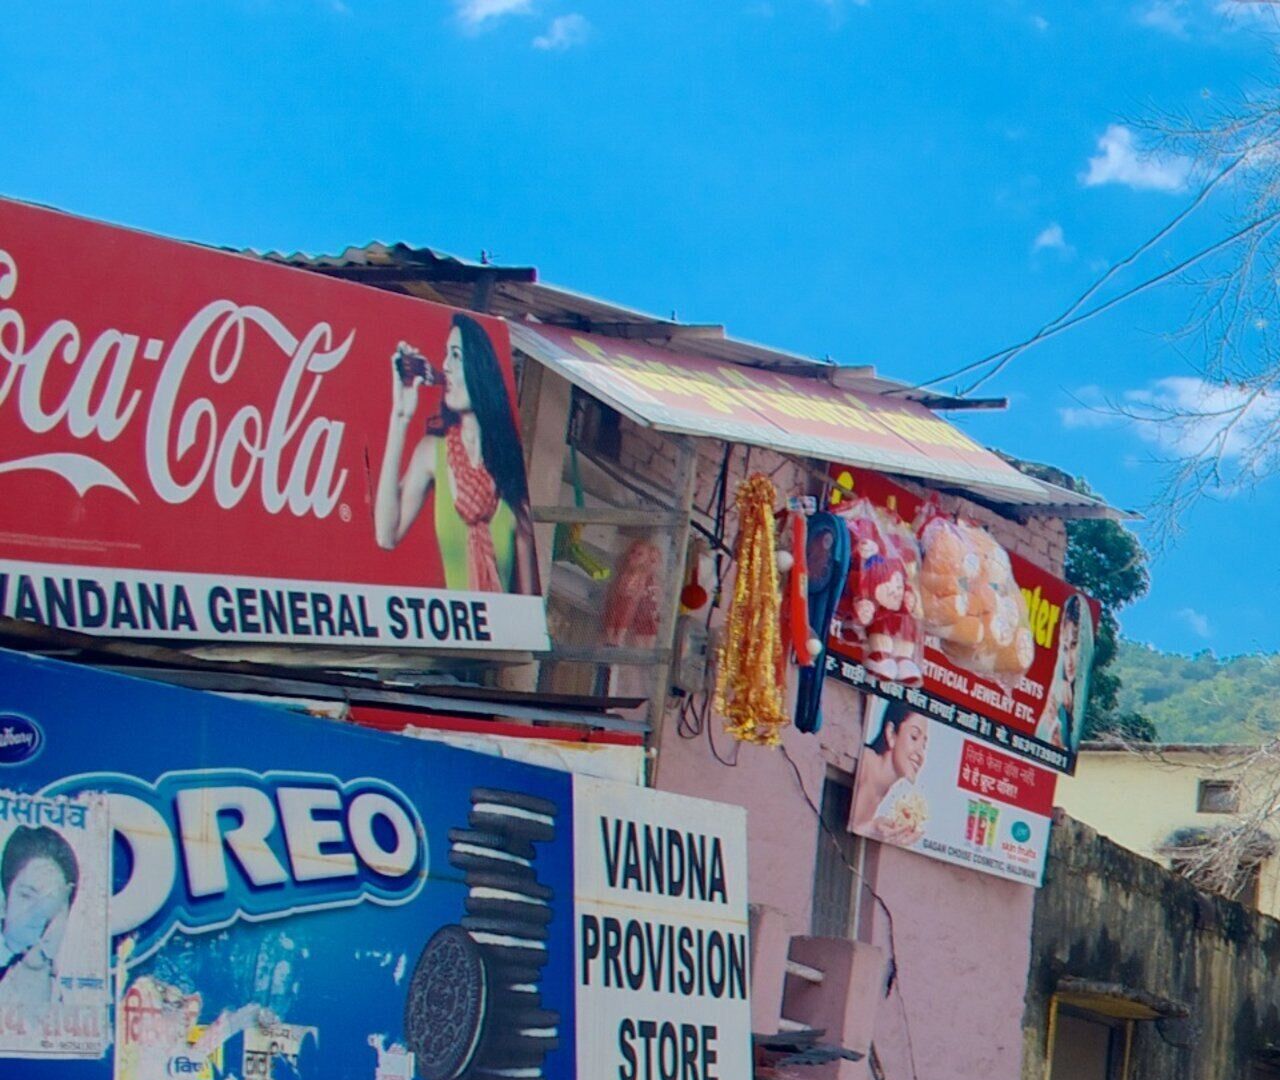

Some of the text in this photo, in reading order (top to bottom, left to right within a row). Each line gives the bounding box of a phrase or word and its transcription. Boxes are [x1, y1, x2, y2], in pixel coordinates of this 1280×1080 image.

[208, 586, 379, 638] GENERAL
[388, 596, 493, 642] STORE
[600, 815, 729, 905] VANDNA
[581, 913, 748, 1000] PROVISION
